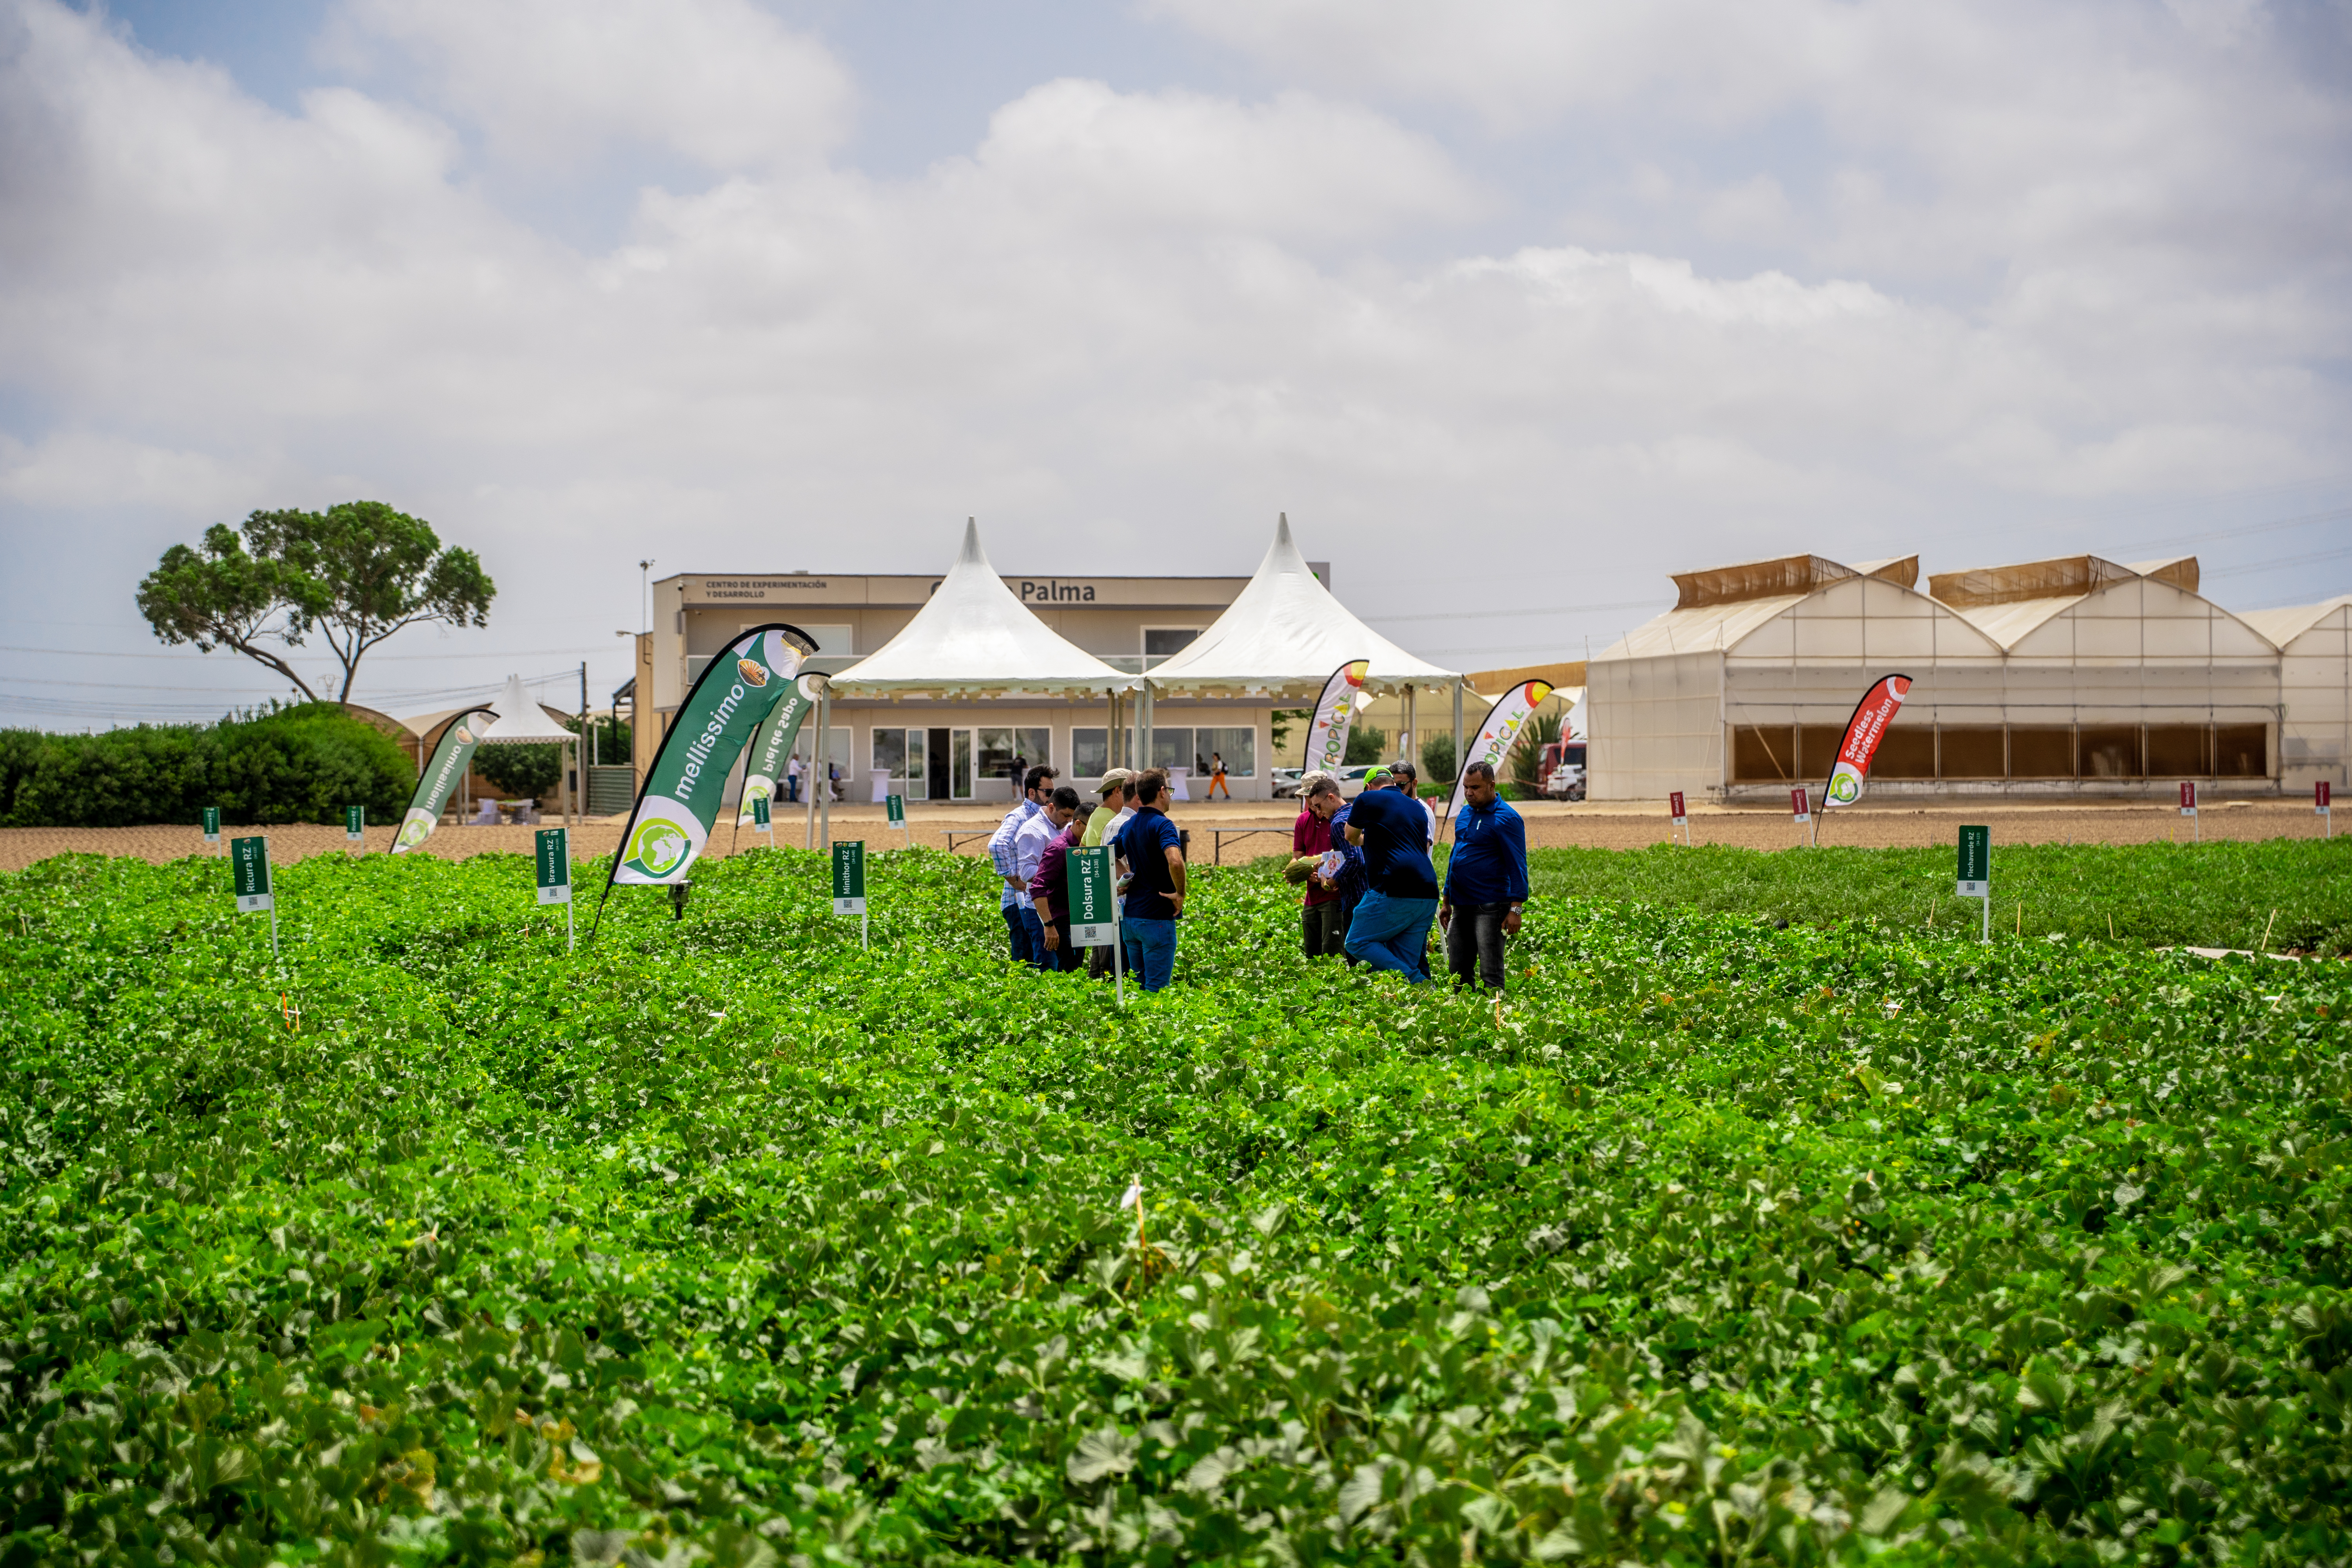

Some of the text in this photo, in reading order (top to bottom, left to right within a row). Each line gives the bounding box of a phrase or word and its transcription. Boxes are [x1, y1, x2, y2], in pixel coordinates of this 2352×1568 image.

[753, 579, 827, 588] EXPERIMENTACIÓN
[1021, 581, 1095, 601] Palma
[1484, 710, 1524, 765] OPICAL
[1845, 709, 1874, 760] Seedless
[1855, 698, 1893, 764] Watermelon
[547, 839, 554, 850] RZ
[842, 850, 849, 860] RZ
[243, 847, 255, 892] Ricura RZ
[1081, 859, 1091, 874] RZ
[1082, 877, 1094, 920] Dolsura
